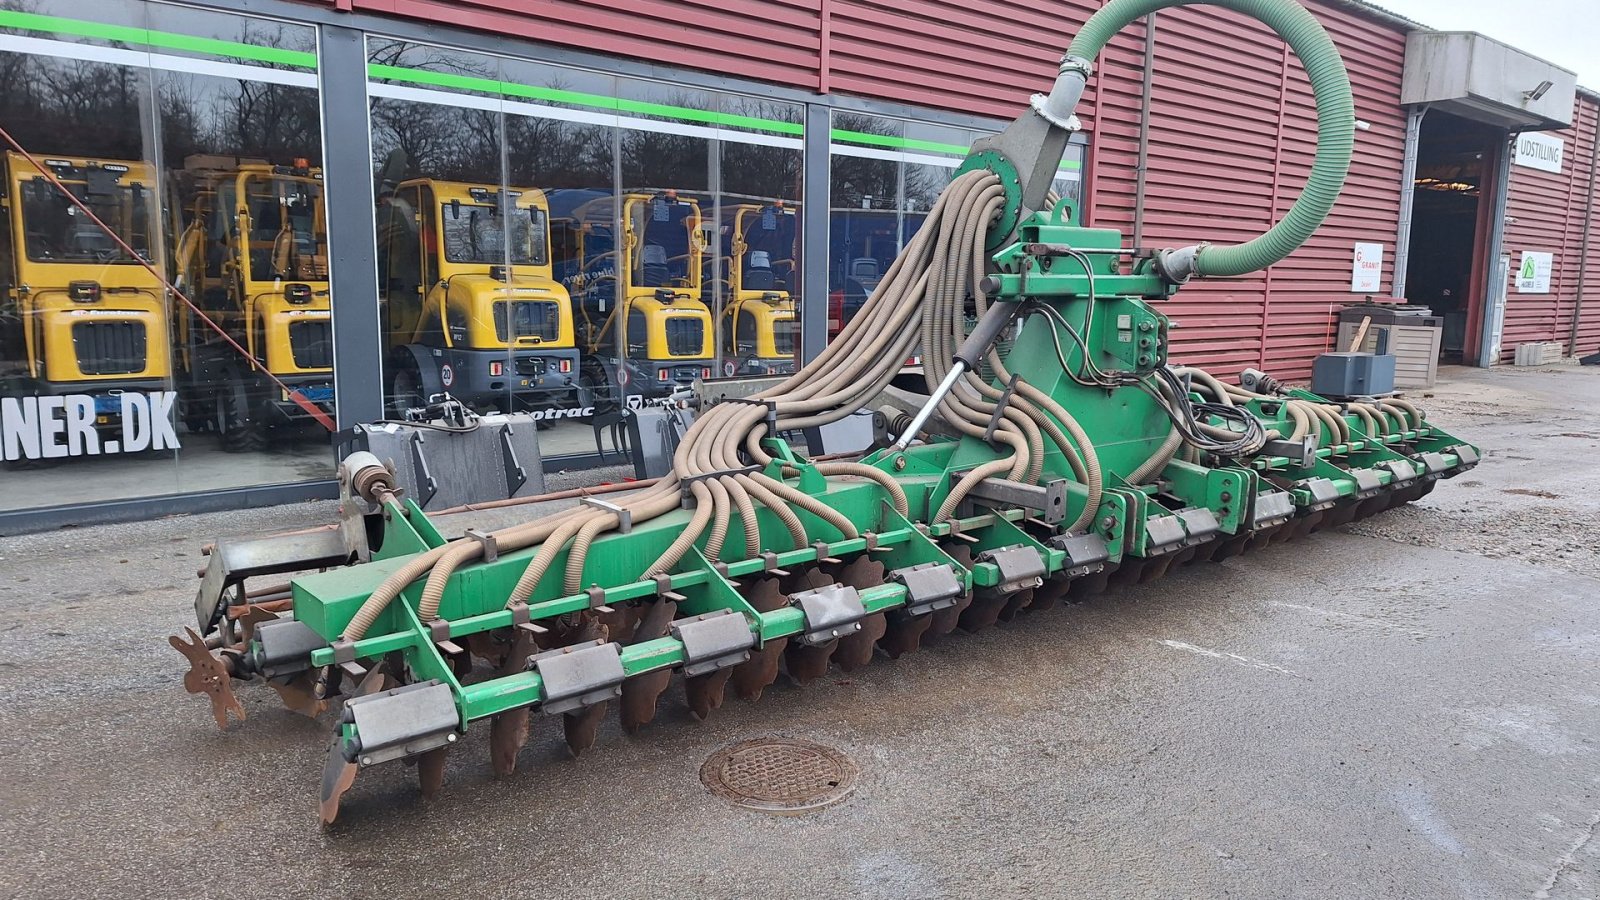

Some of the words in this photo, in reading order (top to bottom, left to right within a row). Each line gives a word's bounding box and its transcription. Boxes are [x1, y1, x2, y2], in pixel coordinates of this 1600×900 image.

[1520, 139, 1560, 163] UDSTILLING
[443, 368, 451, 380] 20
[0, 391, 181, 462] NER.DK
